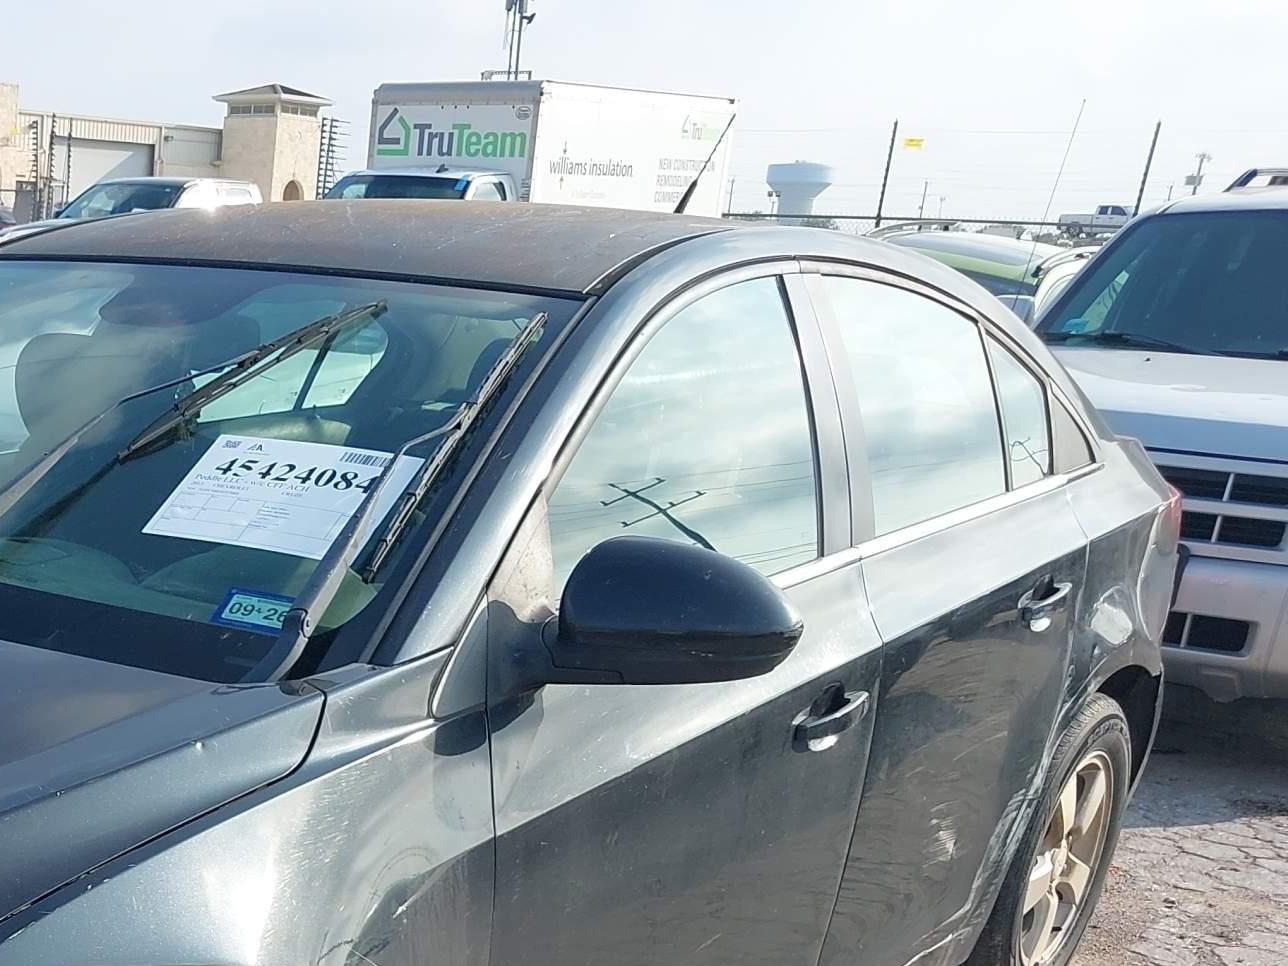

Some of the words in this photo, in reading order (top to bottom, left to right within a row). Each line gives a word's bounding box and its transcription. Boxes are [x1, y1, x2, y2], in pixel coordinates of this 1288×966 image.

[413, 123, 527, 158] TruTeam
[549, 157, 587, 175] williams
[588, 158, 633, 177] insulation
[215, 458, 380, 494] 45424084
[228, 602, 255, 616] 09
